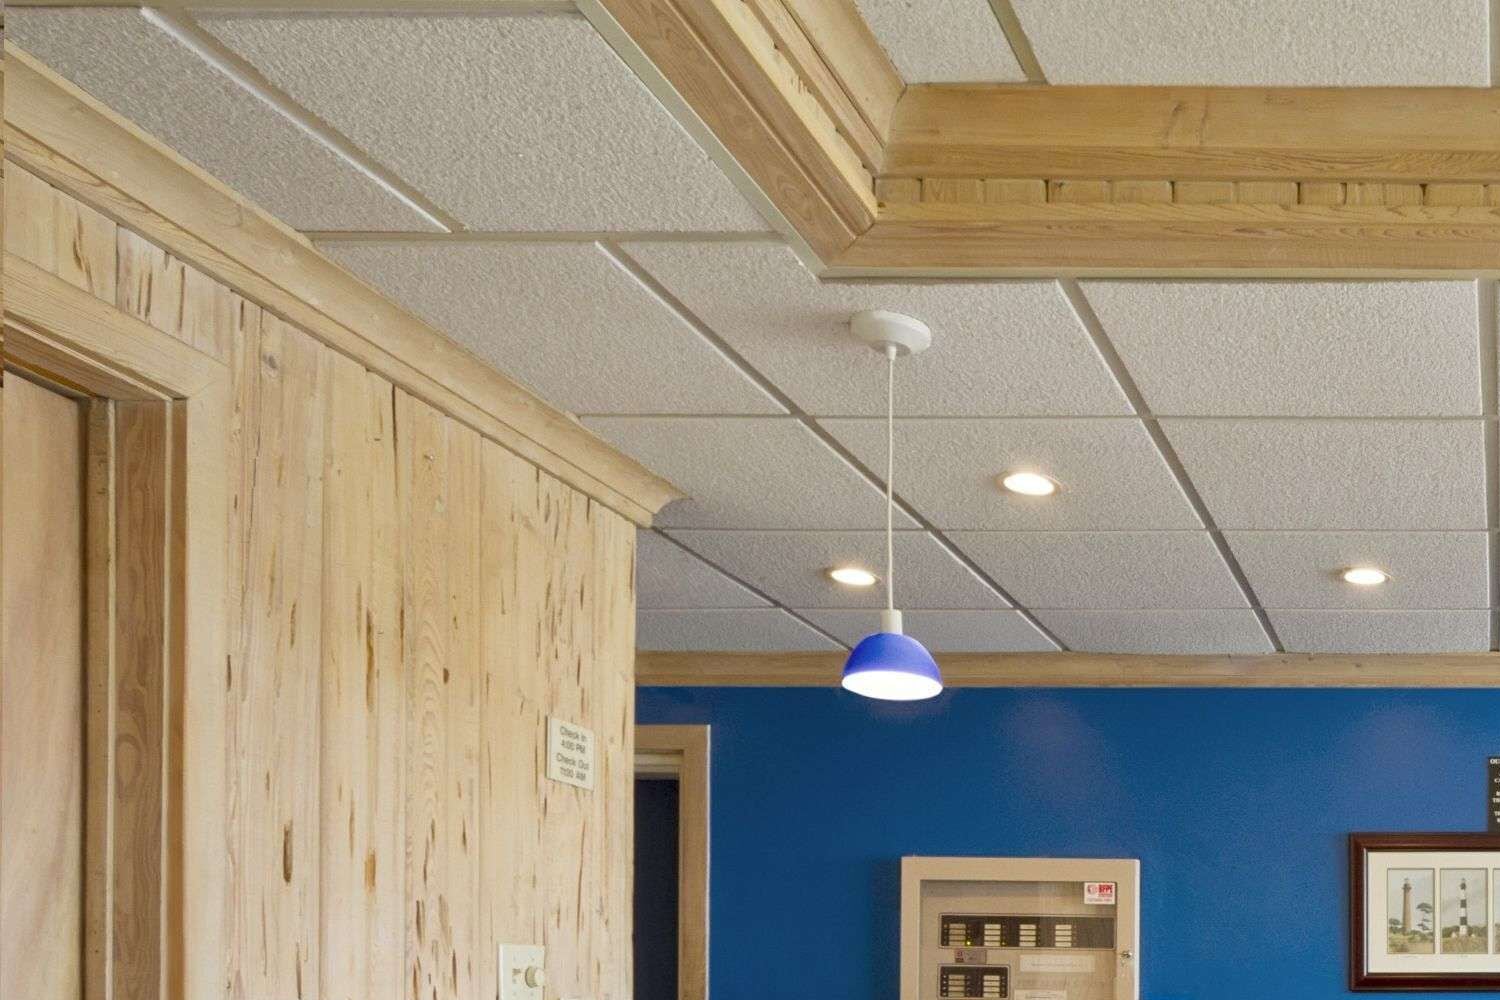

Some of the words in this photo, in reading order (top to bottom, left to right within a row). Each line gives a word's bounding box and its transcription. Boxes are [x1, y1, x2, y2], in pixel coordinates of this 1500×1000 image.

[560, 726, 580, 740] Check
[576, 744, 586, 754] PM
[556, 752, 576, 766] Check
[578, 759, 589, 770] Out
[576, 771, 586, 781] AM
